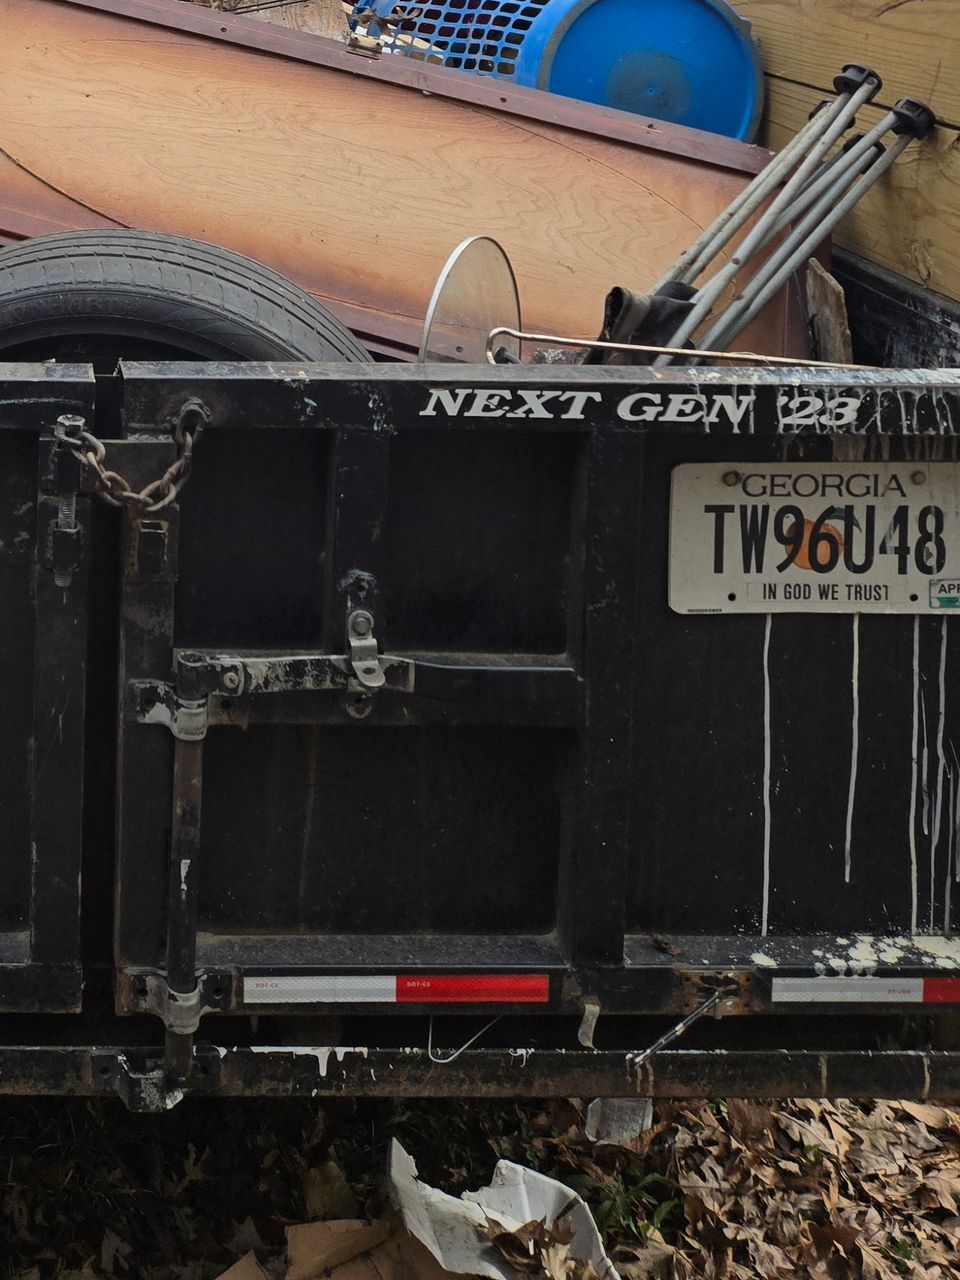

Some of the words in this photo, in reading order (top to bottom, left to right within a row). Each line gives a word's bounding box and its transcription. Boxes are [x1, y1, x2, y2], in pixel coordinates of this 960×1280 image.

[418, 388, 603, 420] NEXT
[616, 391, 755, 423] GEN
[741, 473, 907, 498] GEORGIA
[704, 503, 947, 575] TW96U48
[762, 582, 777, 600] IN
[783, 582, 811, 600] GOD
[818, 583, 839, 601] WE
[845, 583, 889, 601] TRUST
